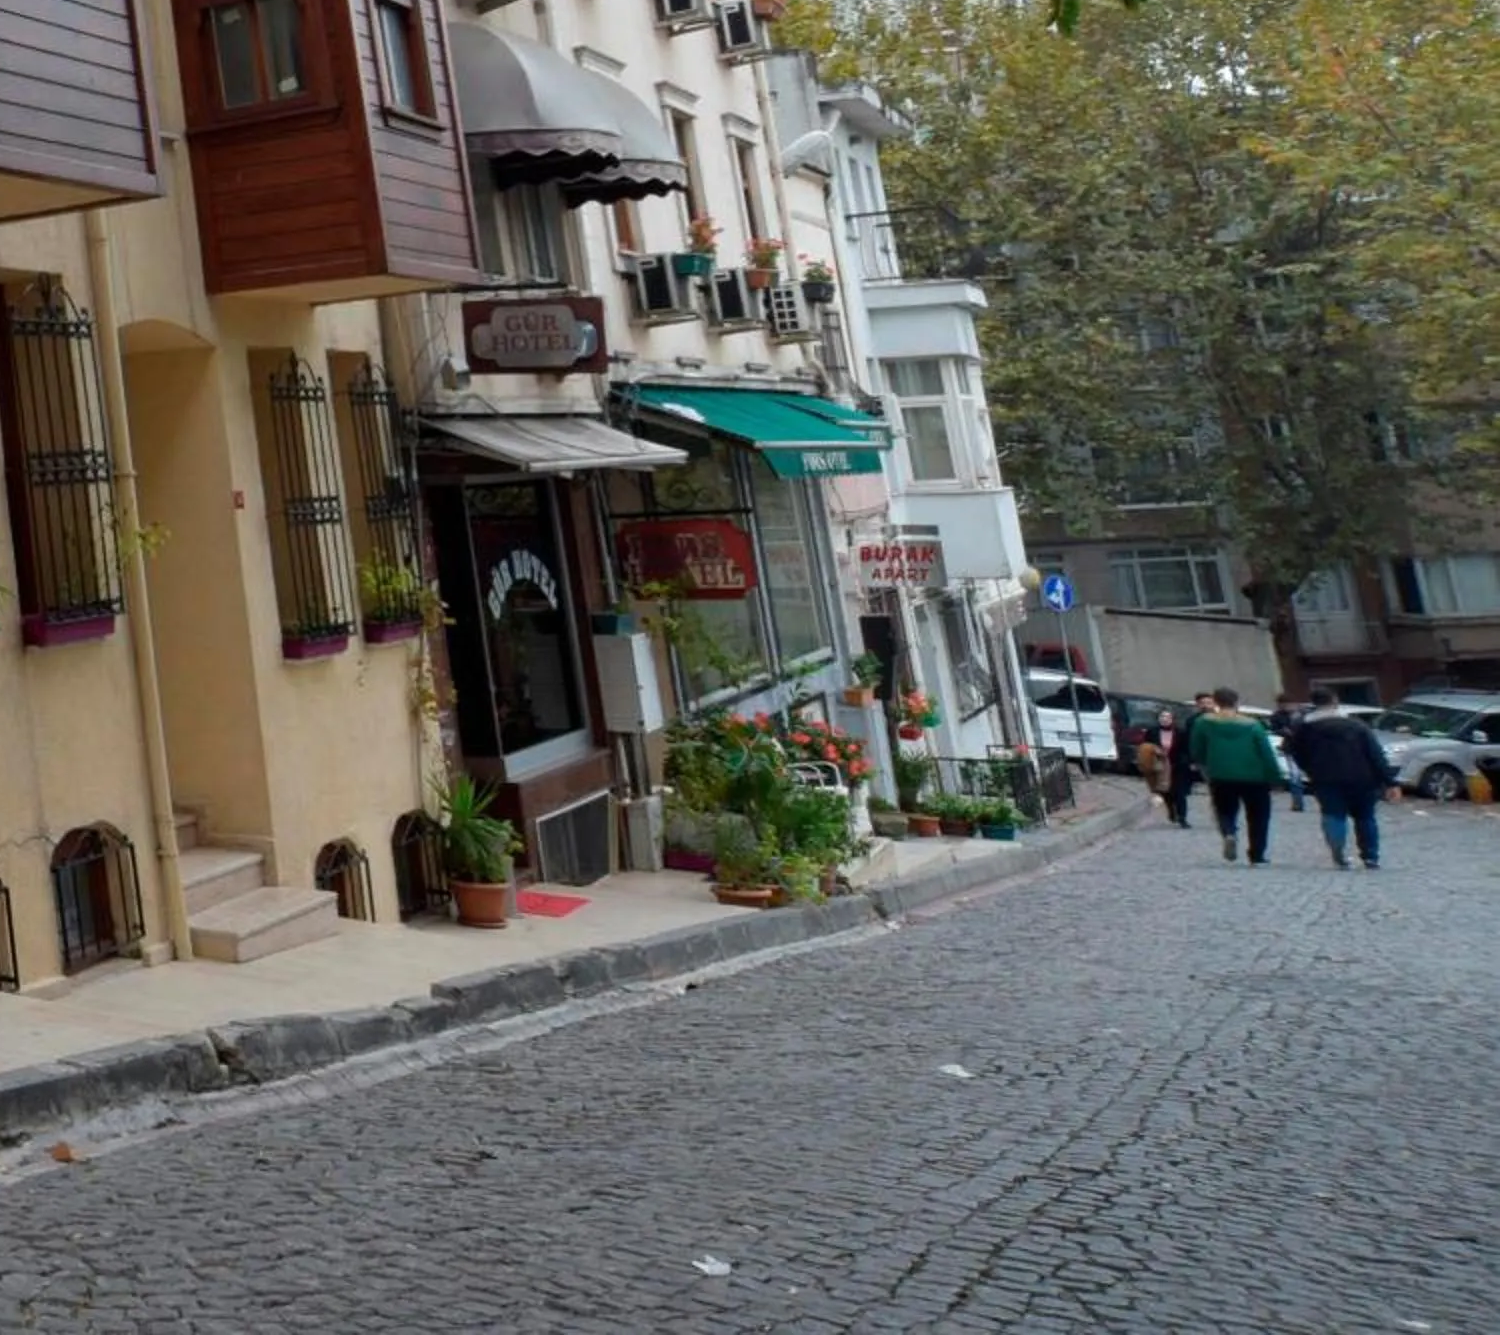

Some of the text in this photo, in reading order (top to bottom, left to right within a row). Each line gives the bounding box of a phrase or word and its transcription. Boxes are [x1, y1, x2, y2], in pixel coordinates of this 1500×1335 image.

[491, 332, 575, 354] HOTEL
[860, 545, 936, 565] BURAK
[871, 567, 929, 582] APART
